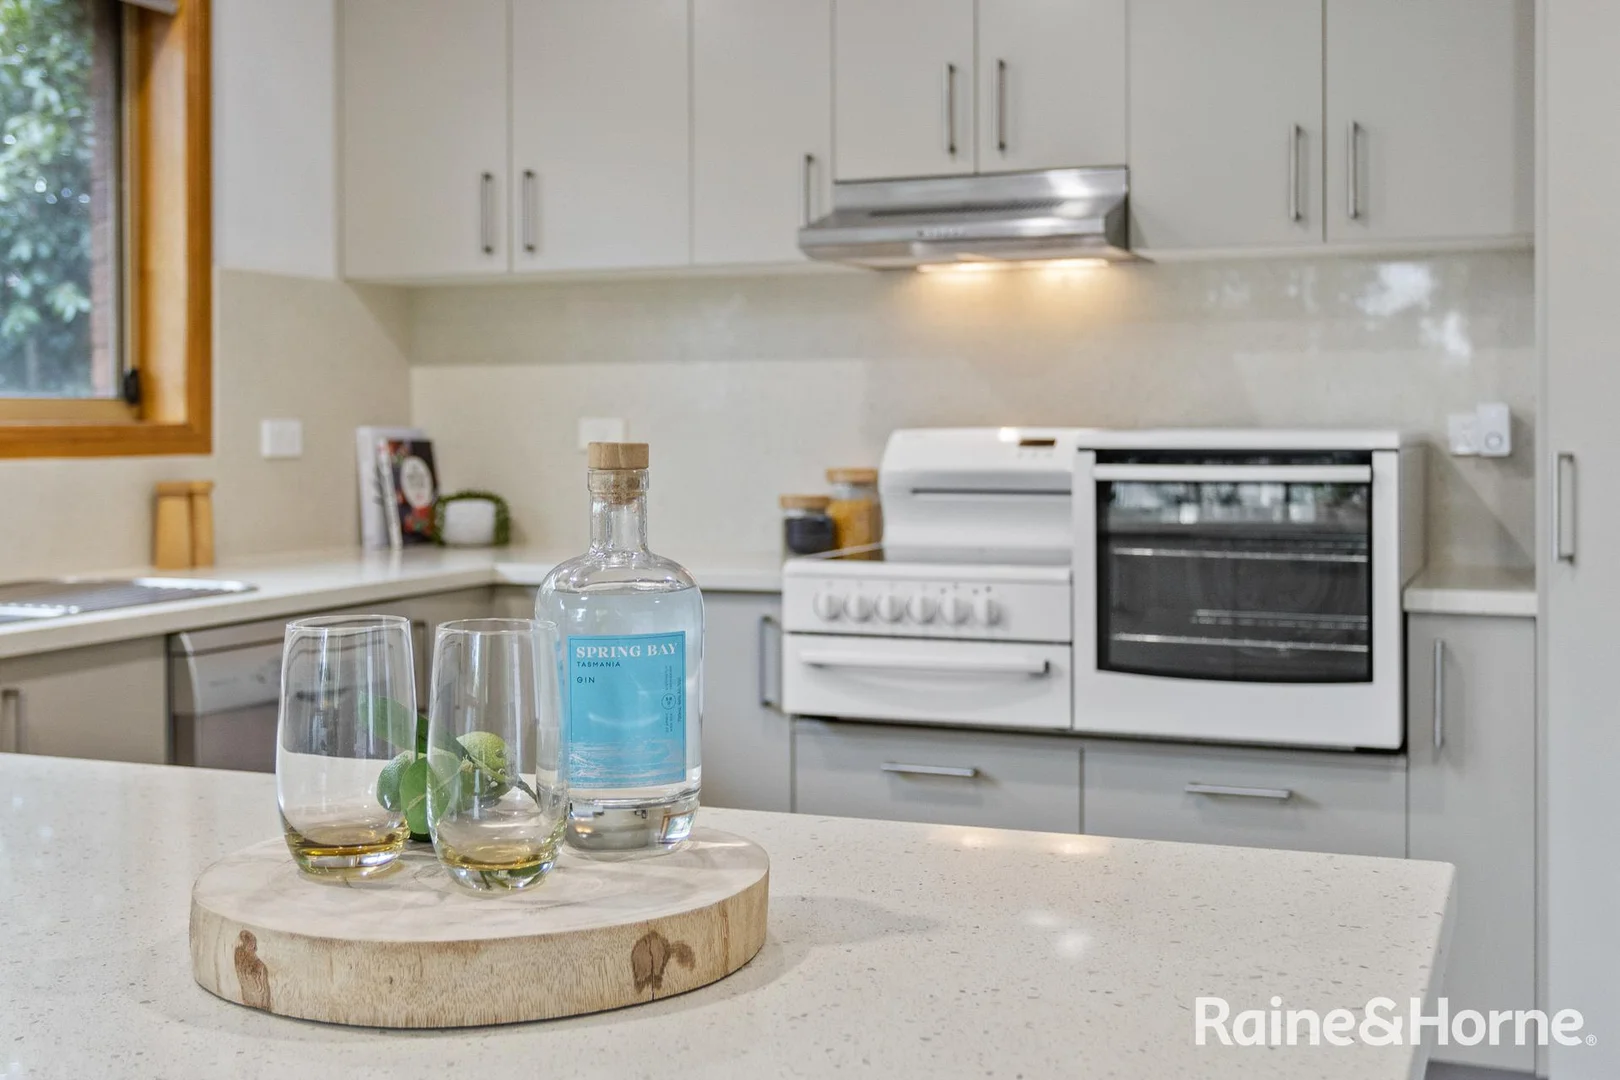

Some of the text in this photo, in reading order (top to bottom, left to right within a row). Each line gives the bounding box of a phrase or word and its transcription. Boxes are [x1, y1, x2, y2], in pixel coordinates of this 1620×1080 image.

[576, 642, 678, 658] SPRING BAY
[576, 676, 595, 684] GIN
